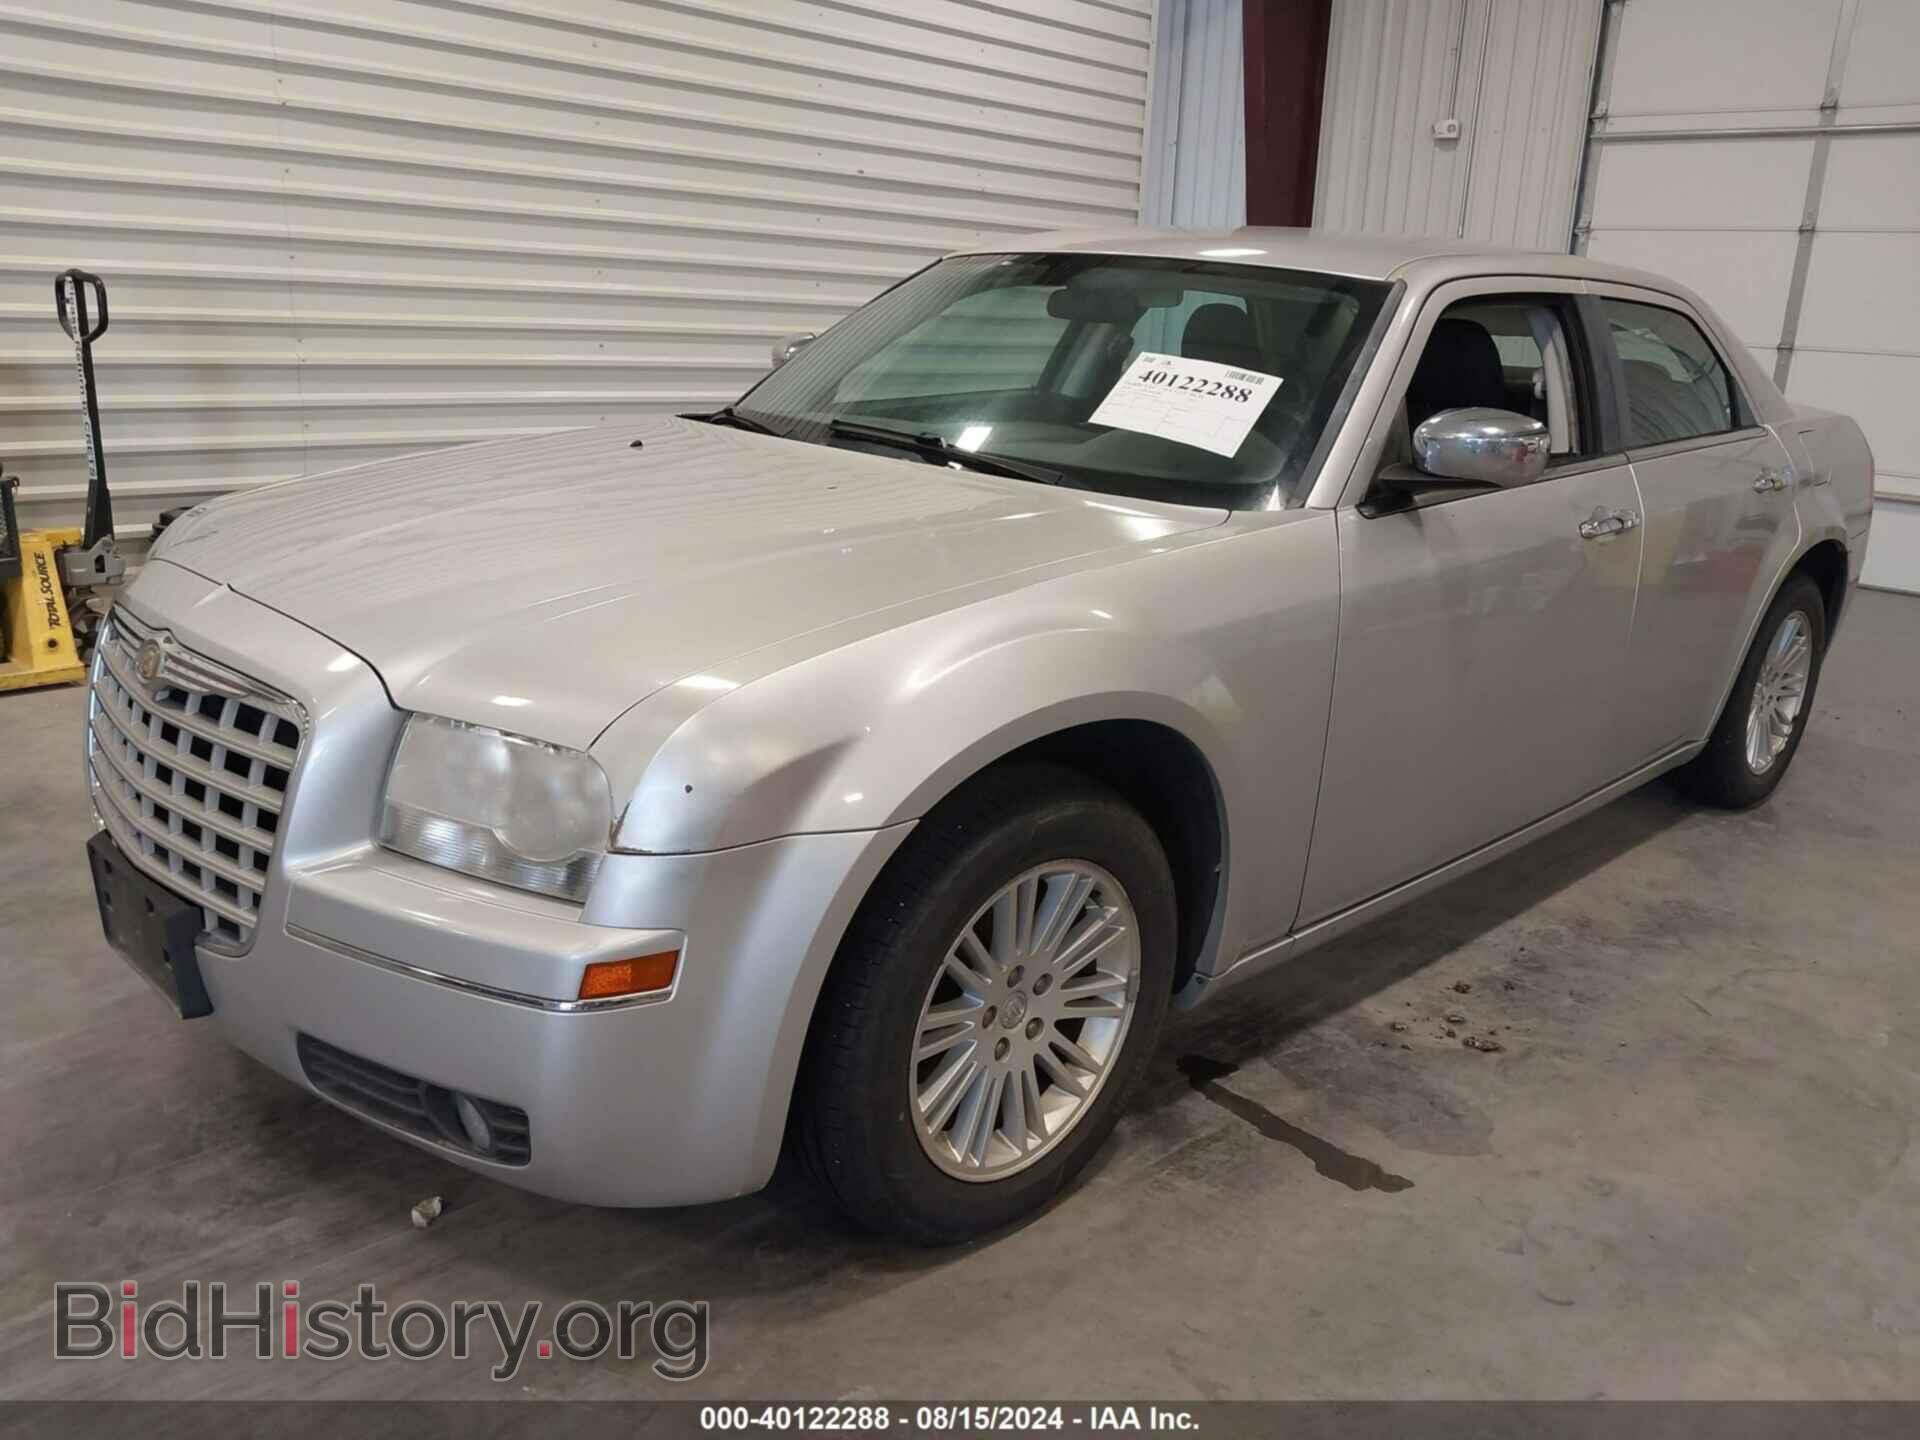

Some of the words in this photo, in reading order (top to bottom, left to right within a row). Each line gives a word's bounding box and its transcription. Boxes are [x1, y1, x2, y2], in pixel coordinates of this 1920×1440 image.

[1138, 369, 1253, 403] 40122288
[34, 552, 53, 595] SOURCE
[46, 597, 61, 629] TOTAL
